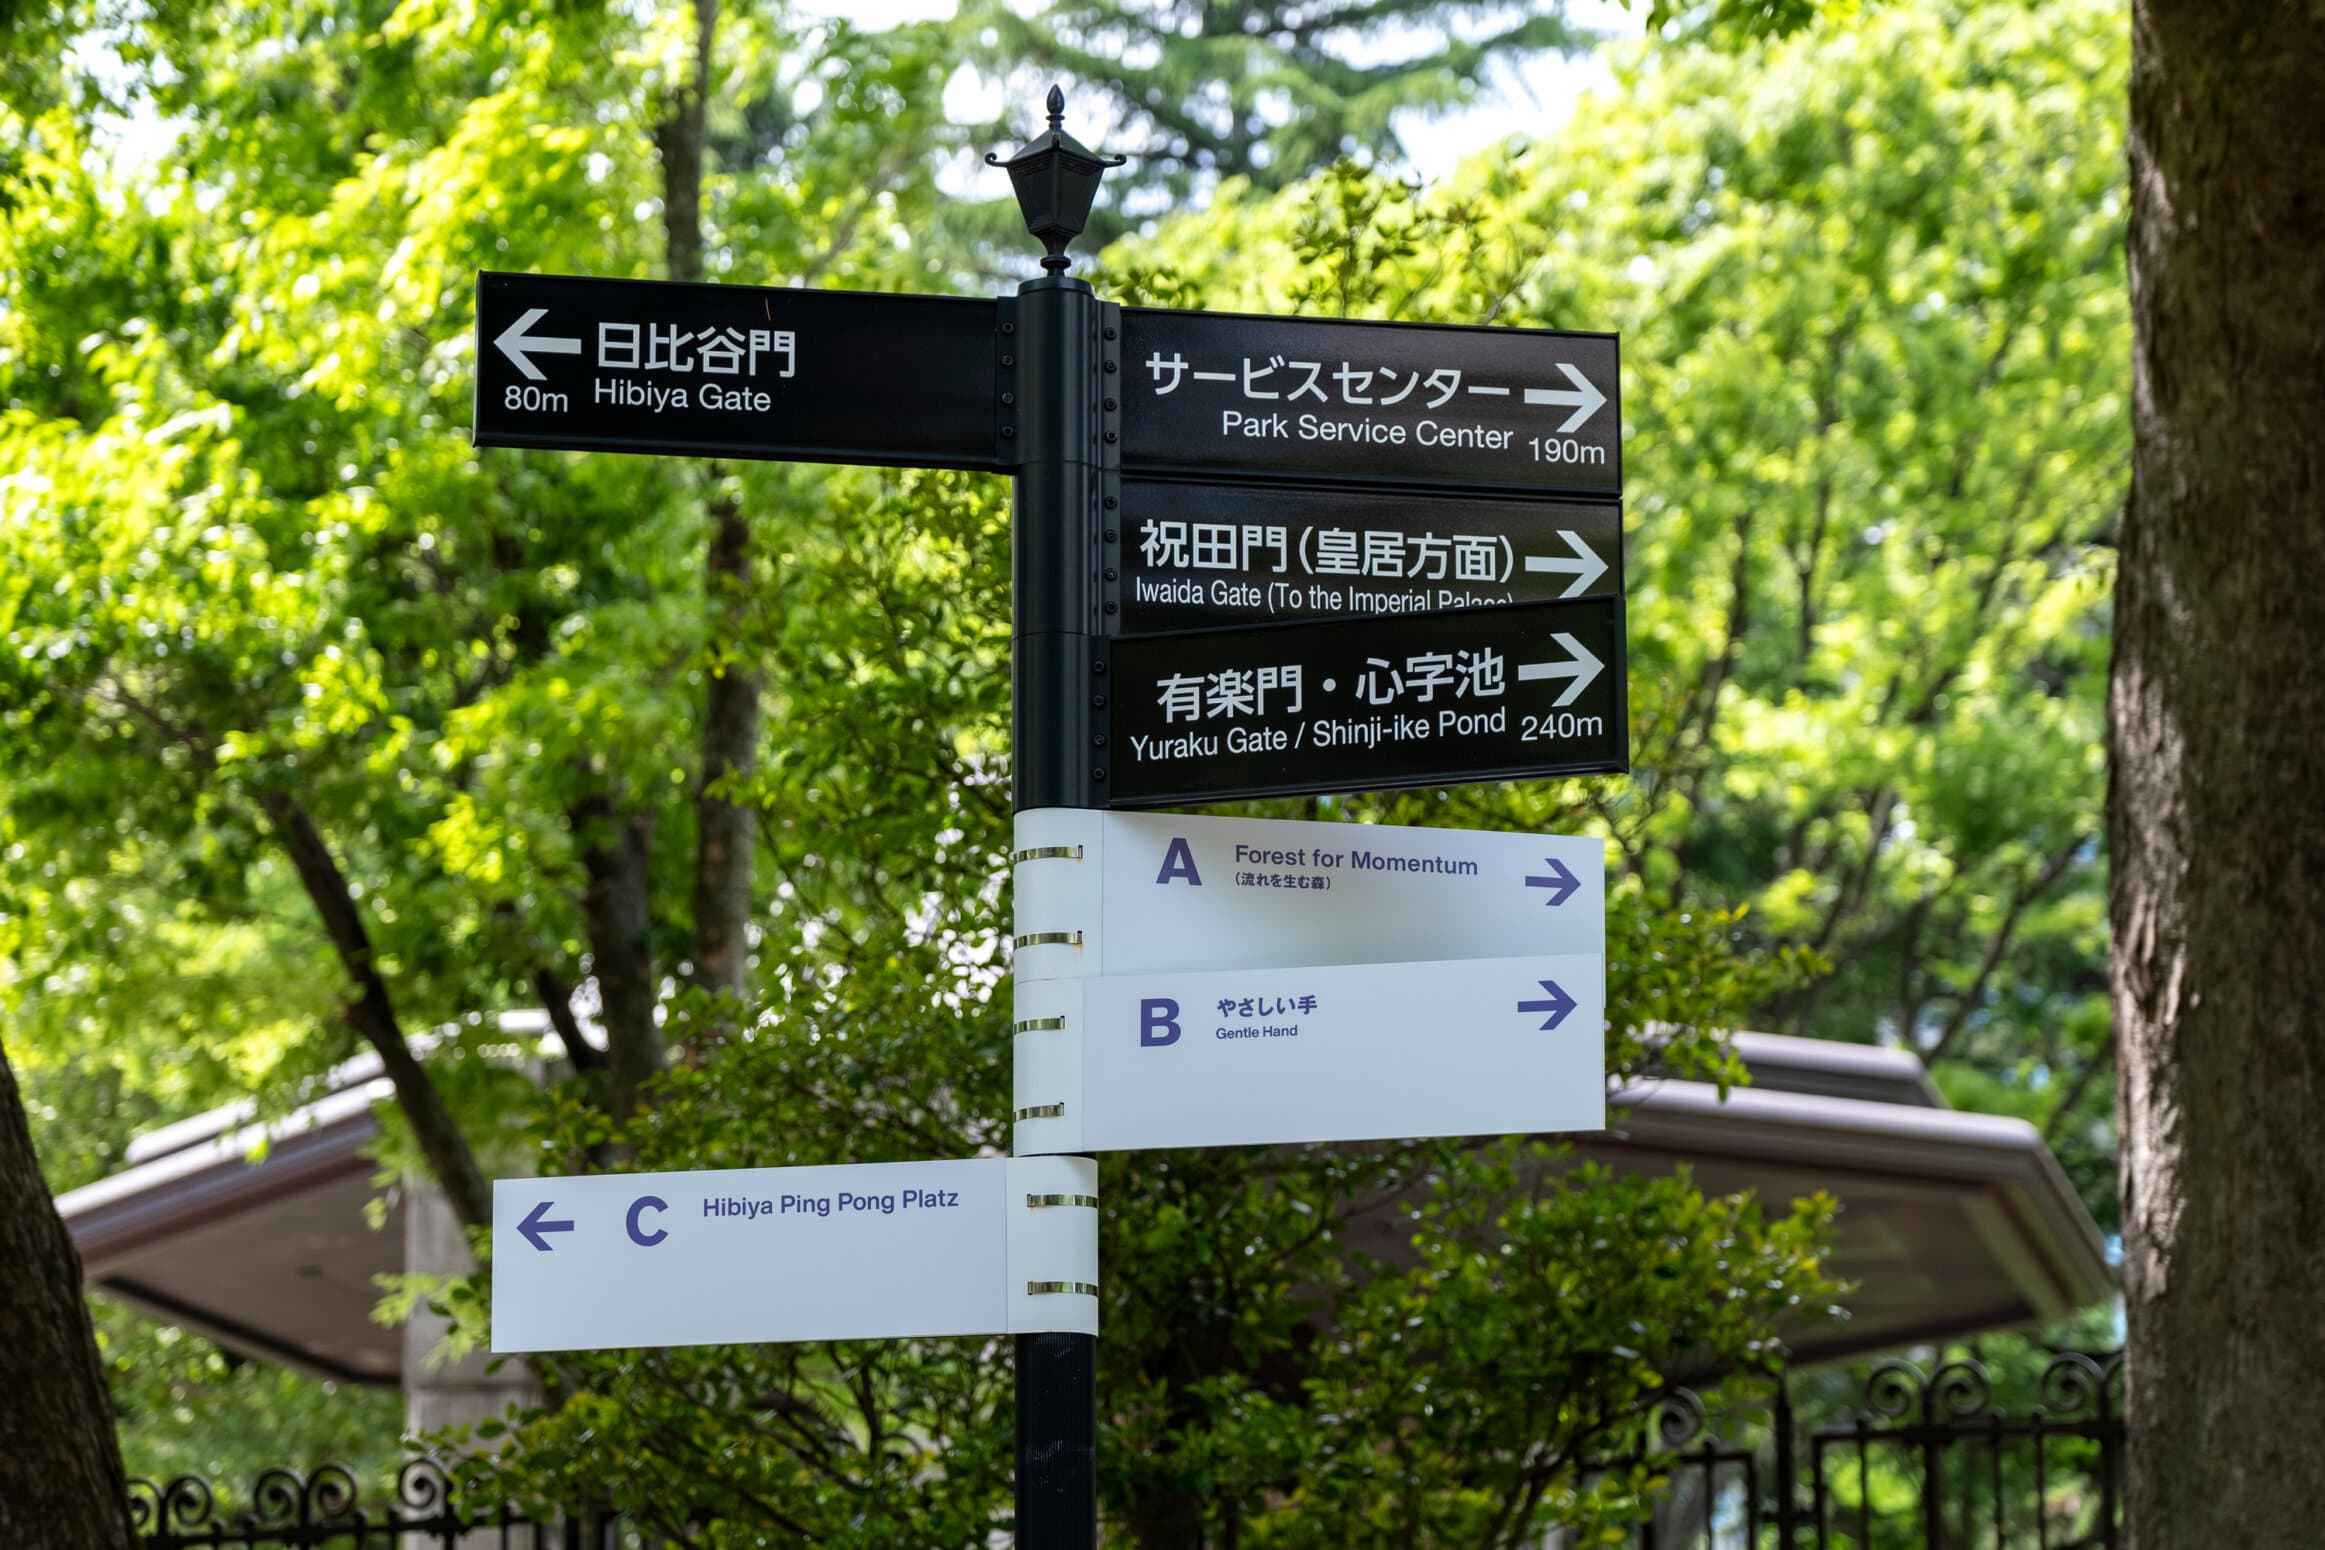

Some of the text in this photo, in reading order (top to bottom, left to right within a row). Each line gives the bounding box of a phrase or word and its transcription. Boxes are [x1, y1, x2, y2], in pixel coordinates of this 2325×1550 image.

[598, 322, 796, 378] 日比谷門
[504, 385, 568, 413] 80m
[594, 378, 771, 413] Hibiya Gate
[1145, 351, 1511, 409] サービスセンター
[1223, 410, 1514, 450] Park Service Center
[1528, 437, 1605, 465] 190m
[1140, 518, 1514, 584] 祝田門(皇居方面)
[1136, 576, 1205, 604] Iwaida
[1210, 579, 1262, 607] Gate
[1267, 581, 1303, 614] (To
[1308, 584, 1343, 610] the
[1349, 585, 1431, 615] Imperial
[1156, 647, 1506, 723] 有楽門・心字池
[1130, 706, 1506, 762] Yuraku Gate / Shinji-ike Pond
[1521, 712, 1603, 742] 240m
[1155, 837, 1203, 887] A
[1234, 843, 1479, 876] Forest for Momentum
[1234, 871, 1332, 892] (流れを生む森)
[1140, 997, 1182, 1048] B
[1216, 994, 1318, 1019] やさしい手
[1215, 1024, 1299, 1040] Gentle Hand
[625, 1195, 669, 1247] C
[703, 1188, 960, 1221] Hibiya Ping Pong Platz
